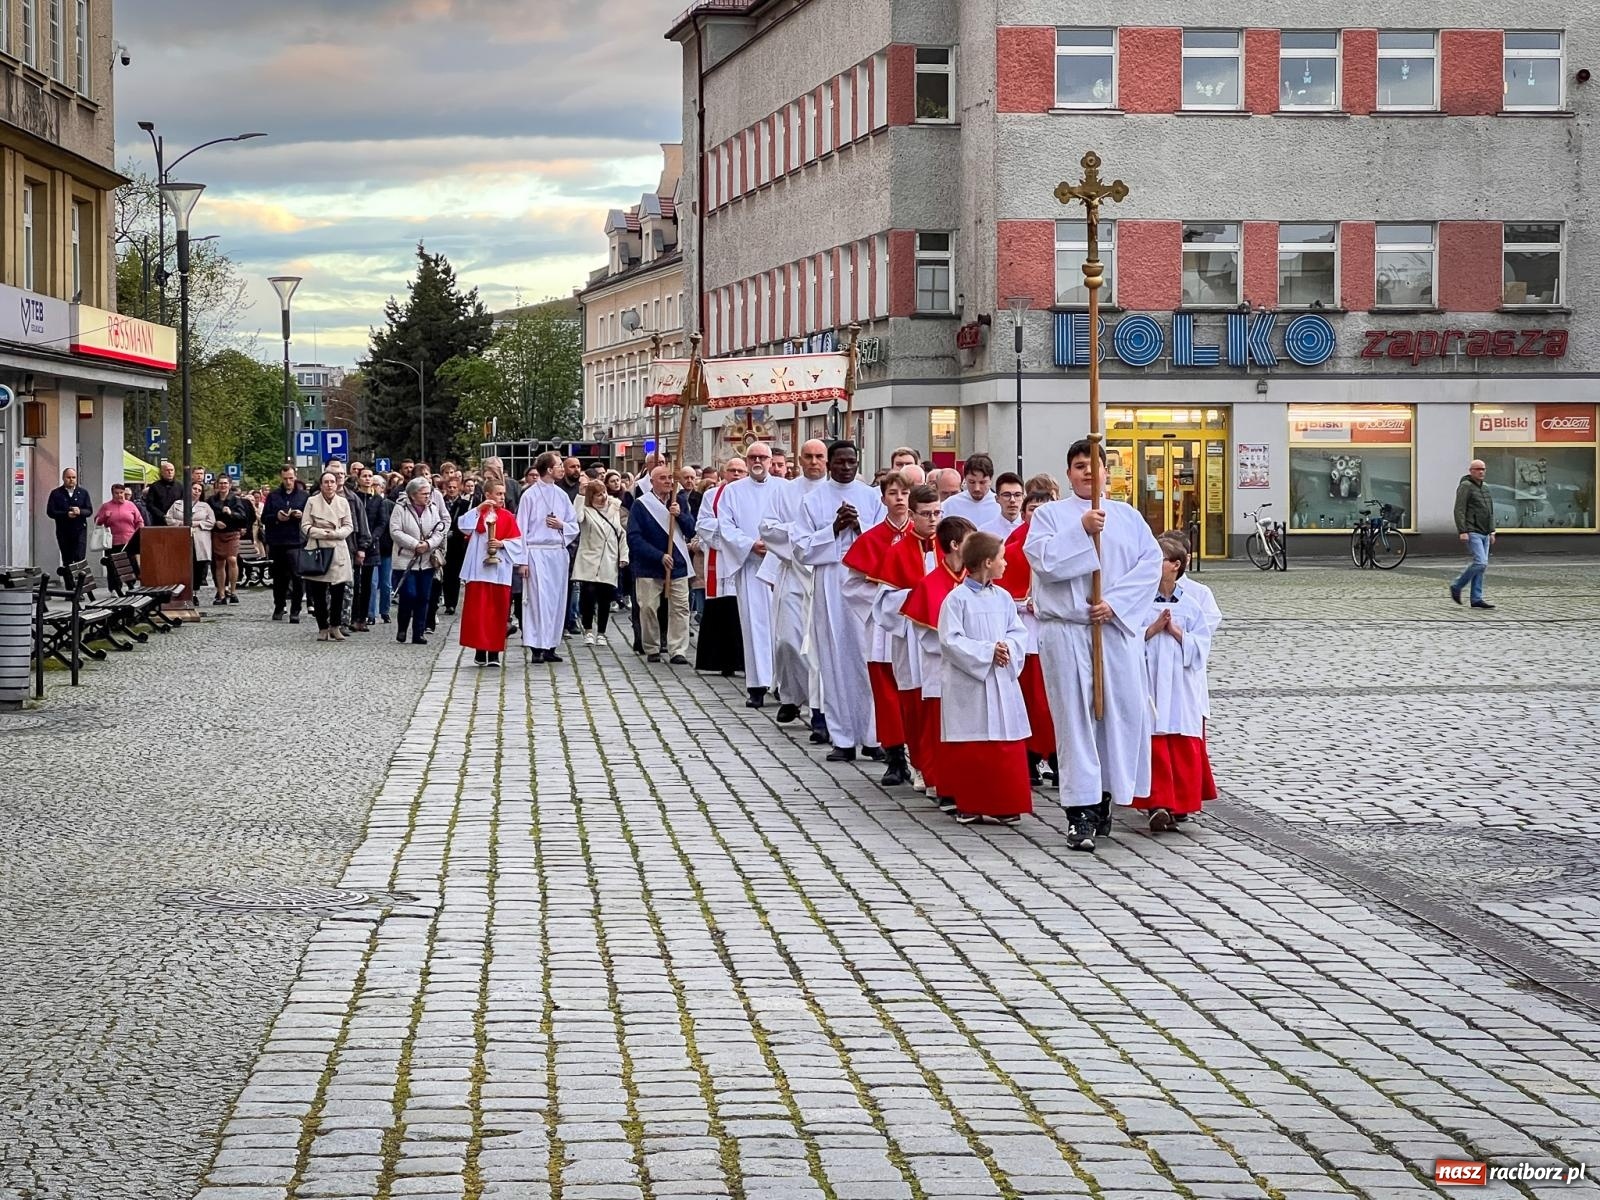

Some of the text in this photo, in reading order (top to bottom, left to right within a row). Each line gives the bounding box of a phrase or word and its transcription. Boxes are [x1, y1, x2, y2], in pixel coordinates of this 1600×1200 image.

[31, 299, 44, 321] TEB
[107, 315, 154, 354] ROSSMANN
[1054, 313, 1569, 368] BOLKO zaprasza
[1494, 417, 1528, 428] Bliski
[151, 428, 161, 441] P
[300, 432, 314, 452] P
[327, 432, 342, 453] P
[204, 473, 213, 483] P
